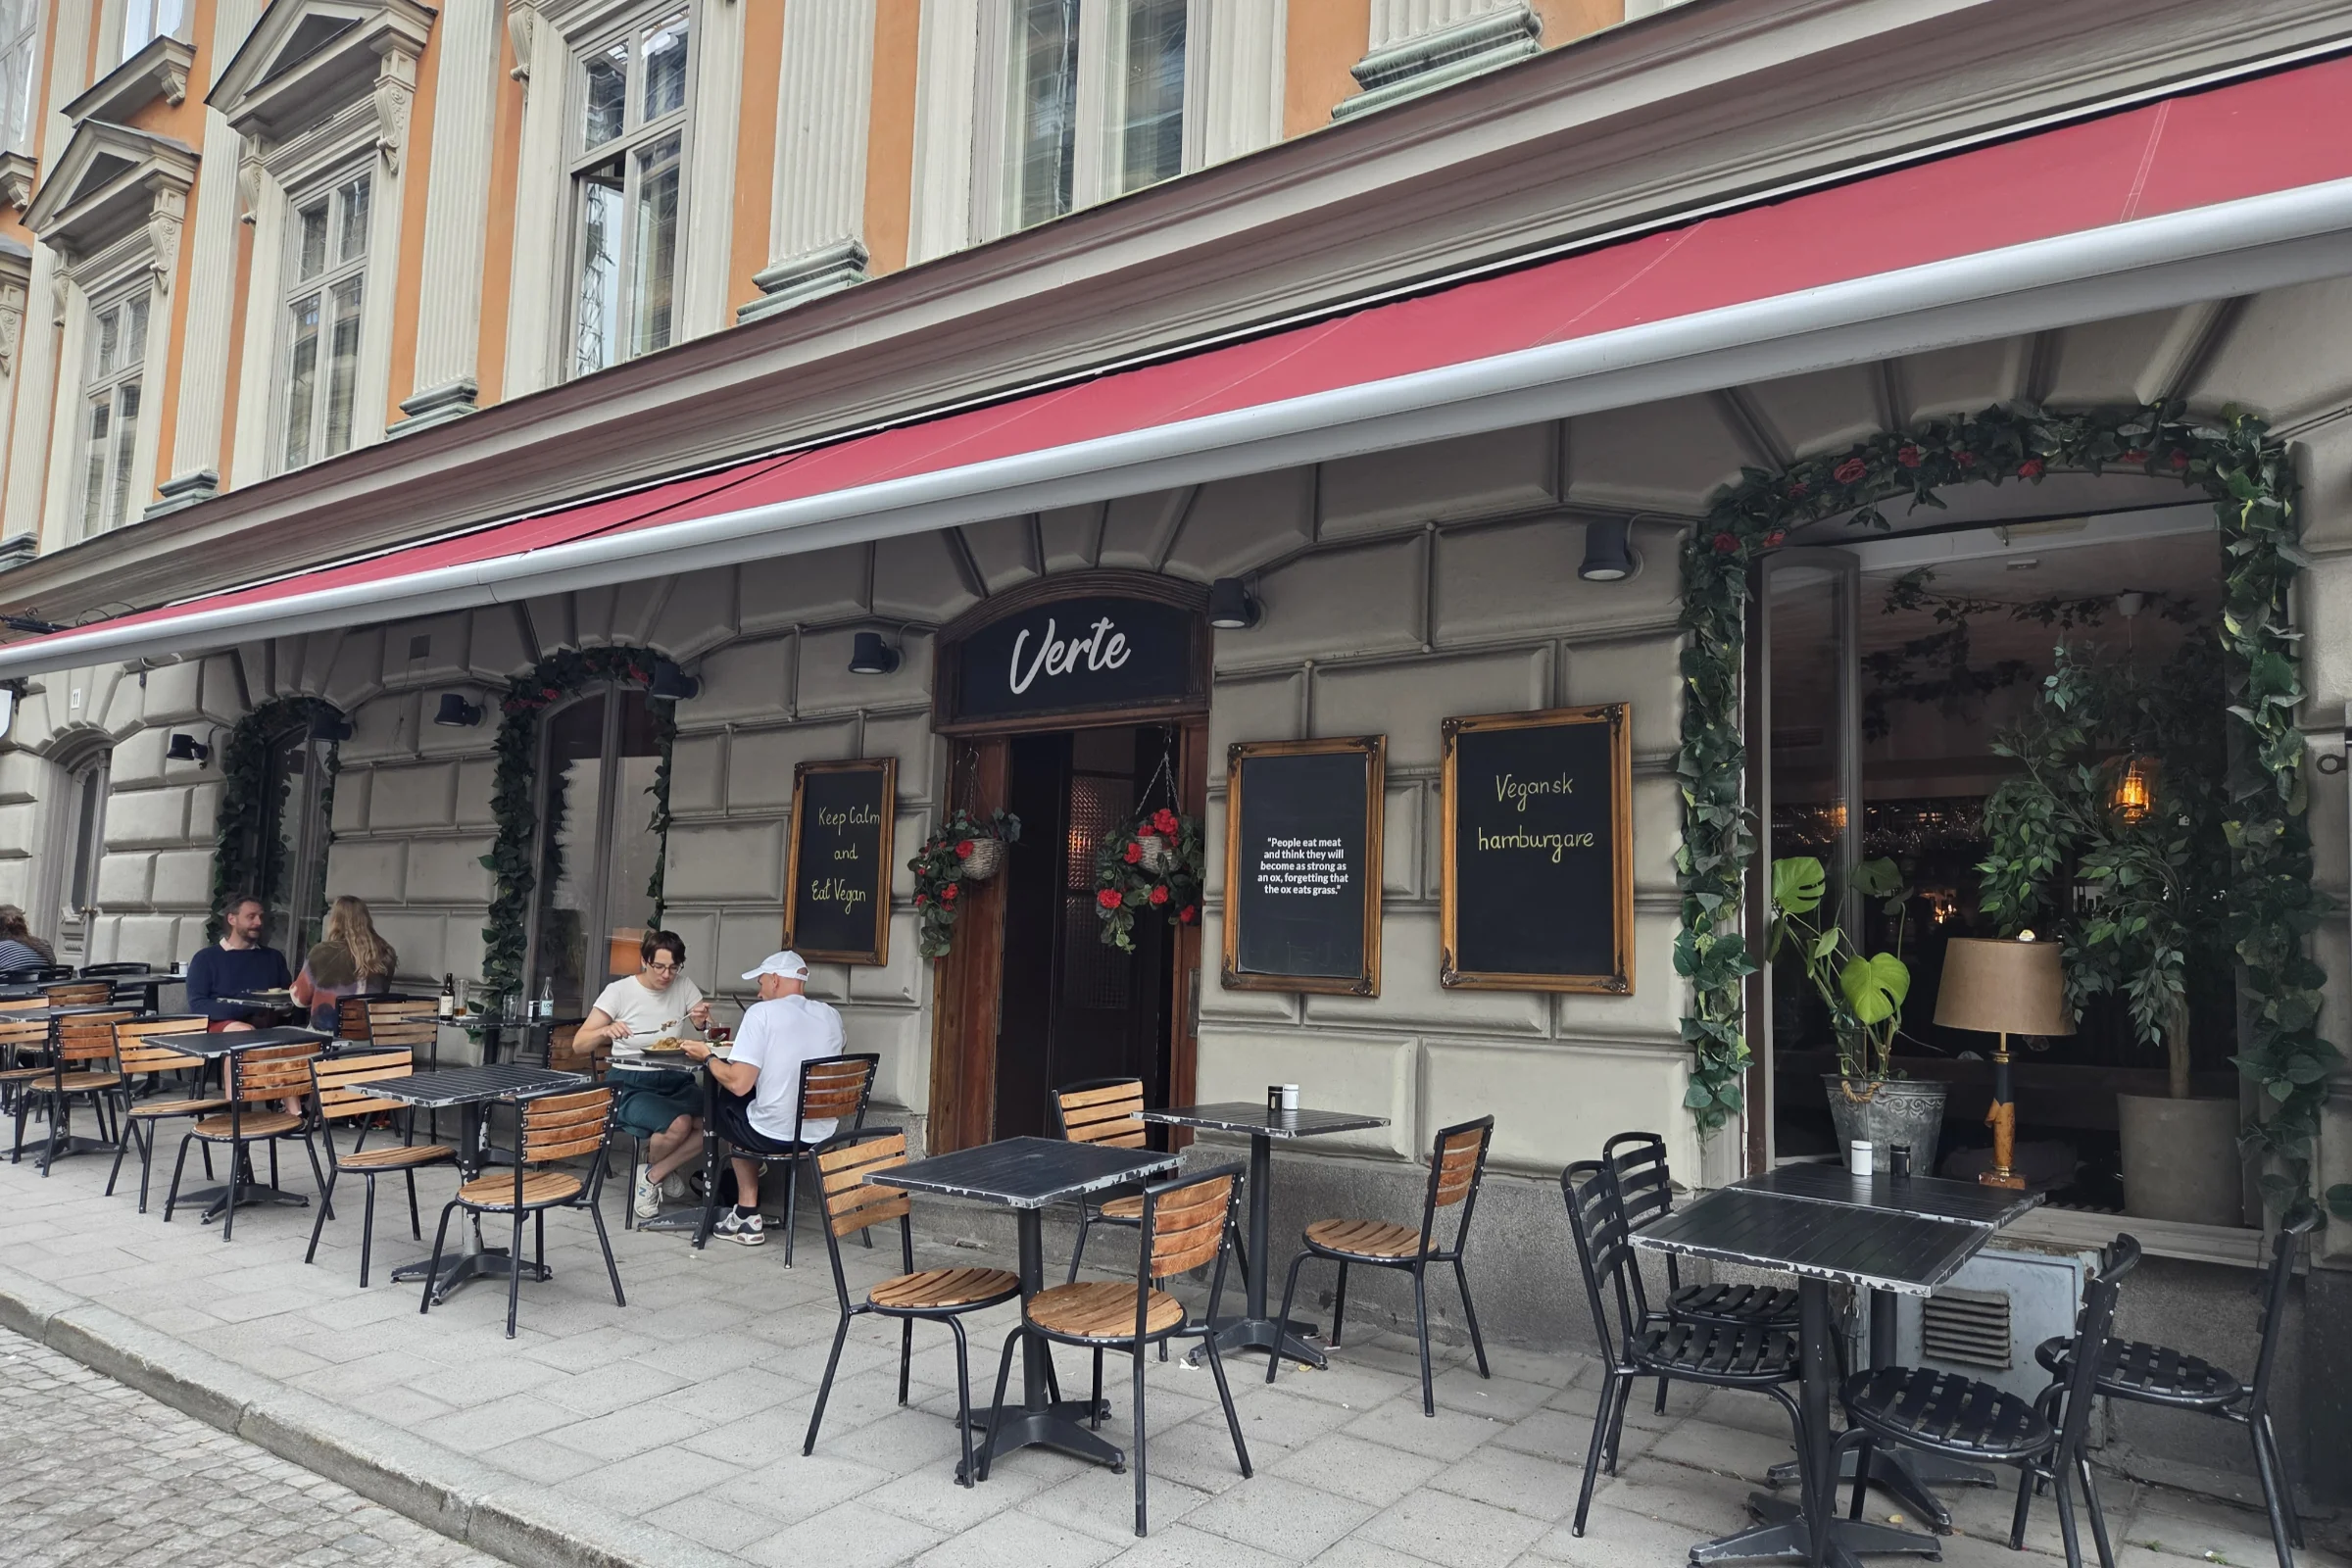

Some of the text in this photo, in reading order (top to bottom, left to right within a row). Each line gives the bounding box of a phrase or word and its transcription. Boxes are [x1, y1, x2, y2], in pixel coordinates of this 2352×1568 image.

[1009, 616, 1132, 695] Verte
[1495, 771, 1574, 812] Vegansk
[818, 804, 880, 836] Keep Calm
[834, 842, 858, 860] and
[1302, 838, 1317, 848] eat
[1318, 837, 1342, 848] meat
[1478, 824, 1595, 863] hamburgare
[1263, 849, 1345, 860] and think they will
[1260, 860, 1347, 872] become as strong as
[1269, 874, 1284, 884] ox,
[1284, 872, 1329, 884] forgetting
[1329, 872, 1349, 883] that
[811, 877, 866, 915] Eat Vegan
[1264, 884, 1280, 894] the
[1293, 884, 1312, 895] eats
